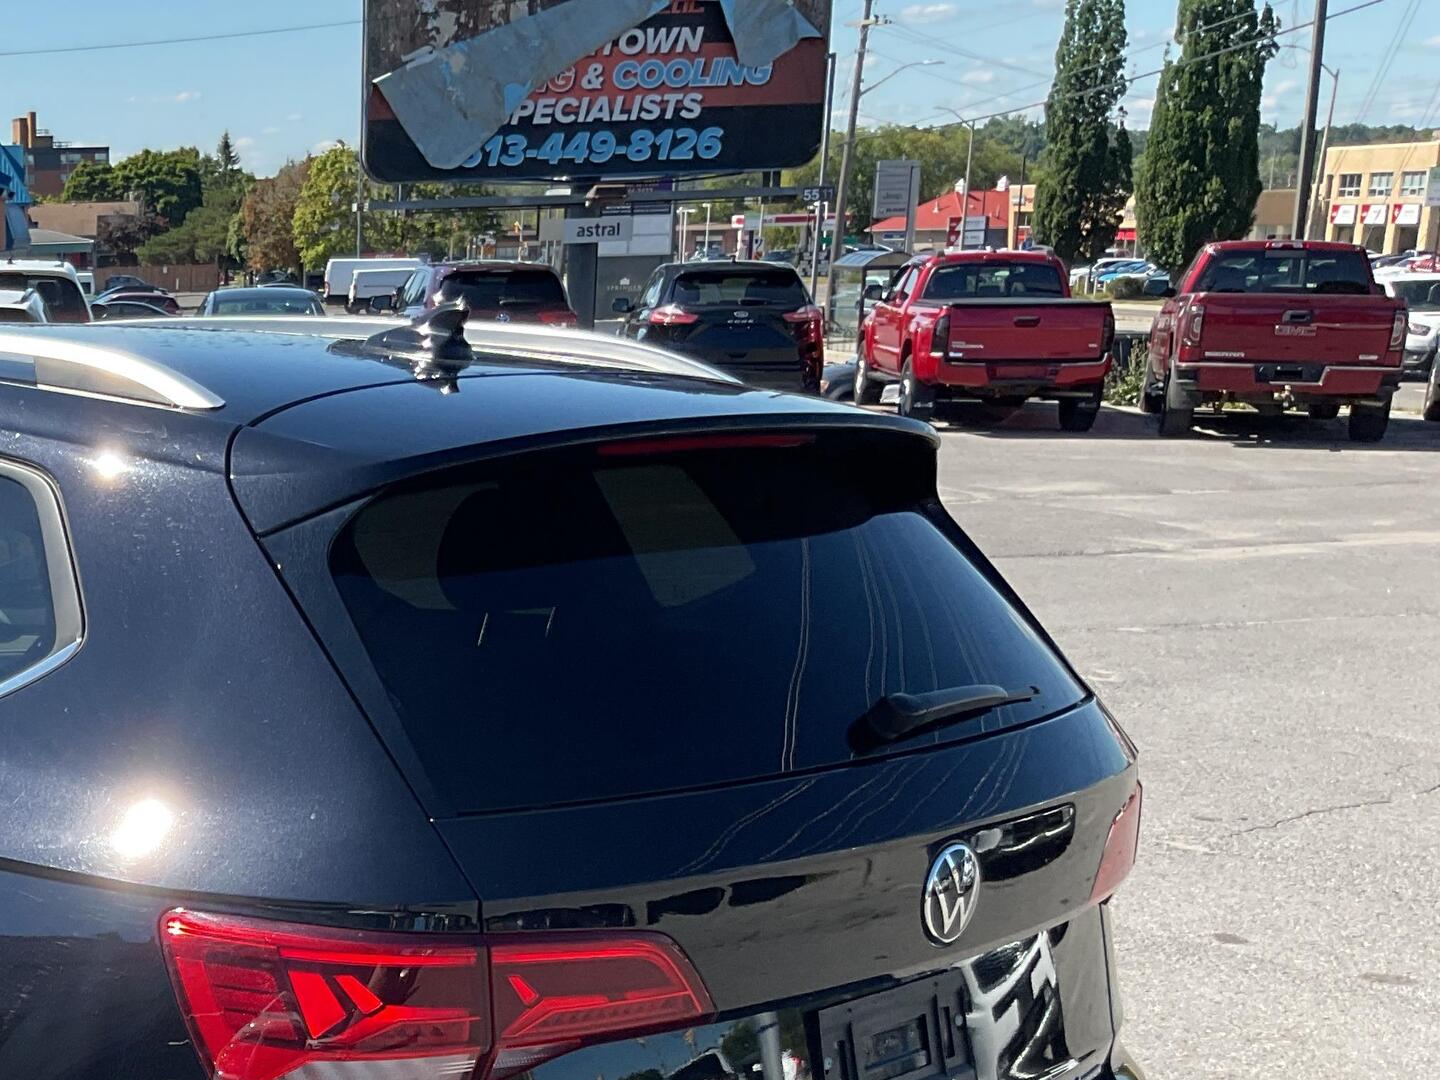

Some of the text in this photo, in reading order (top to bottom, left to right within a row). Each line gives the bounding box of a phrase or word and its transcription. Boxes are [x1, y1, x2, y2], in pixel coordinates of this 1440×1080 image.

[580, 62, 605, 90] &
[613, 56, 774, 90] COOLING
[504, 92, 703, 126] PECIALISTS
[576, 222, 621, 238] astral
